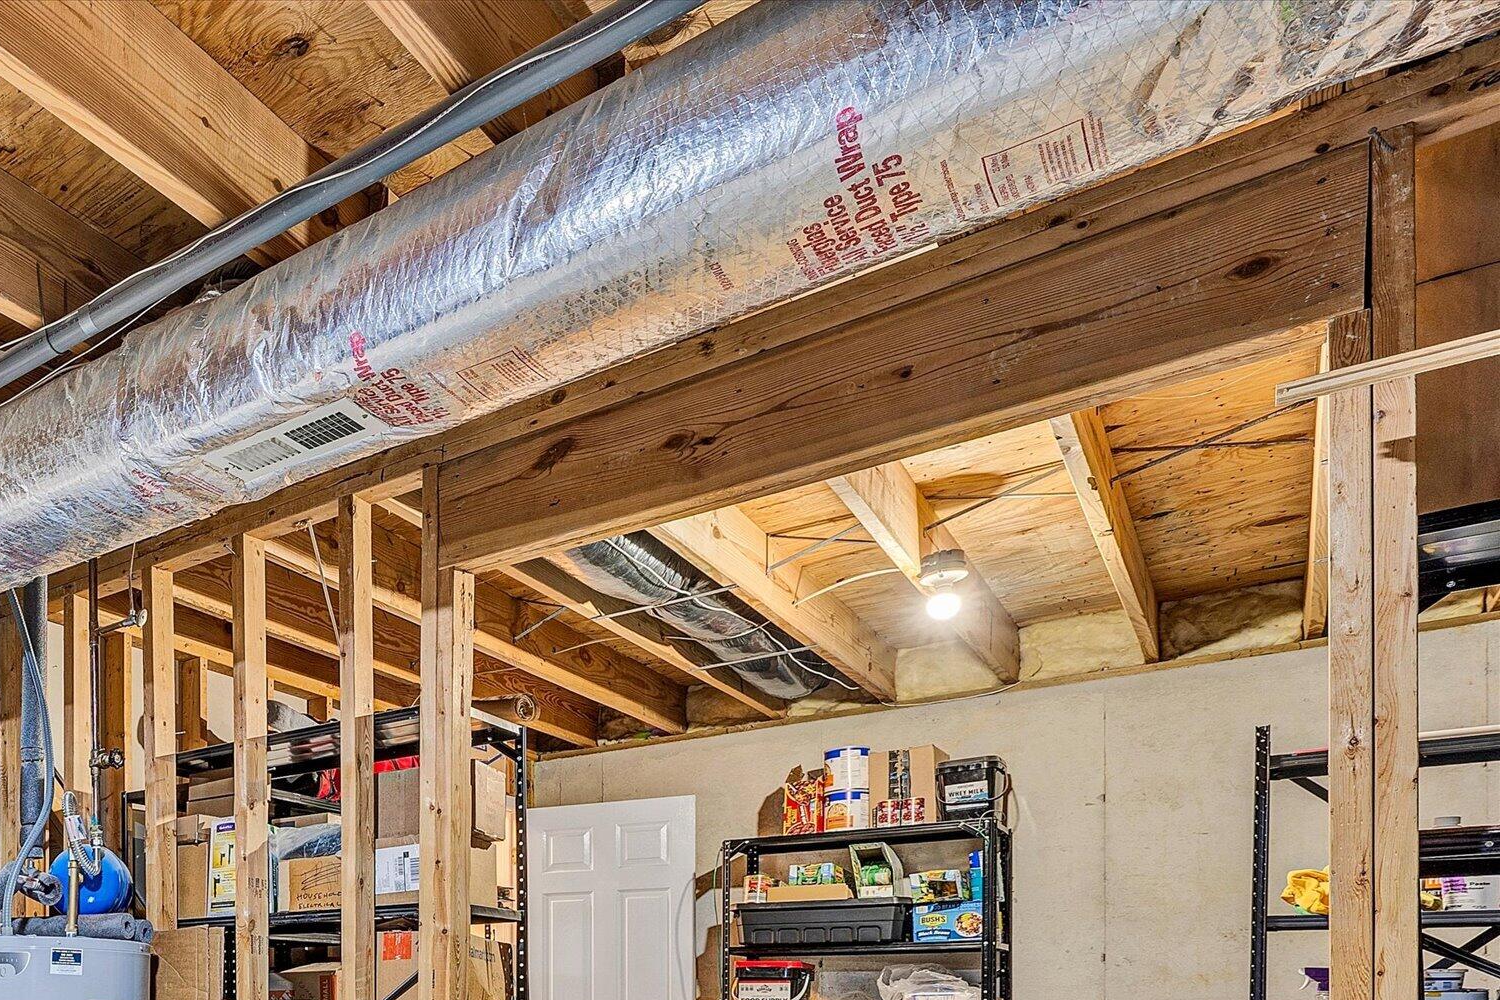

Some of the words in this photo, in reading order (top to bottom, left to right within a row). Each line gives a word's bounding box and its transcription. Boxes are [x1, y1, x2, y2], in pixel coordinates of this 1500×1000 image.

[835, 106, 866, 183] Wrap
[873, 154, 906, 188] 75
[847, 177, 882, 225] Duct
[889, 181, 923, 224] Type
[823, 195, 862, 251] Service
[860, 219, 898, 256] Faced
[372, 378, 401, 403] Duct
[381, 366, 406, 385] 75
[401, 382, 430, 409] Type
[921, 915, 946, 924] BUSH'S
